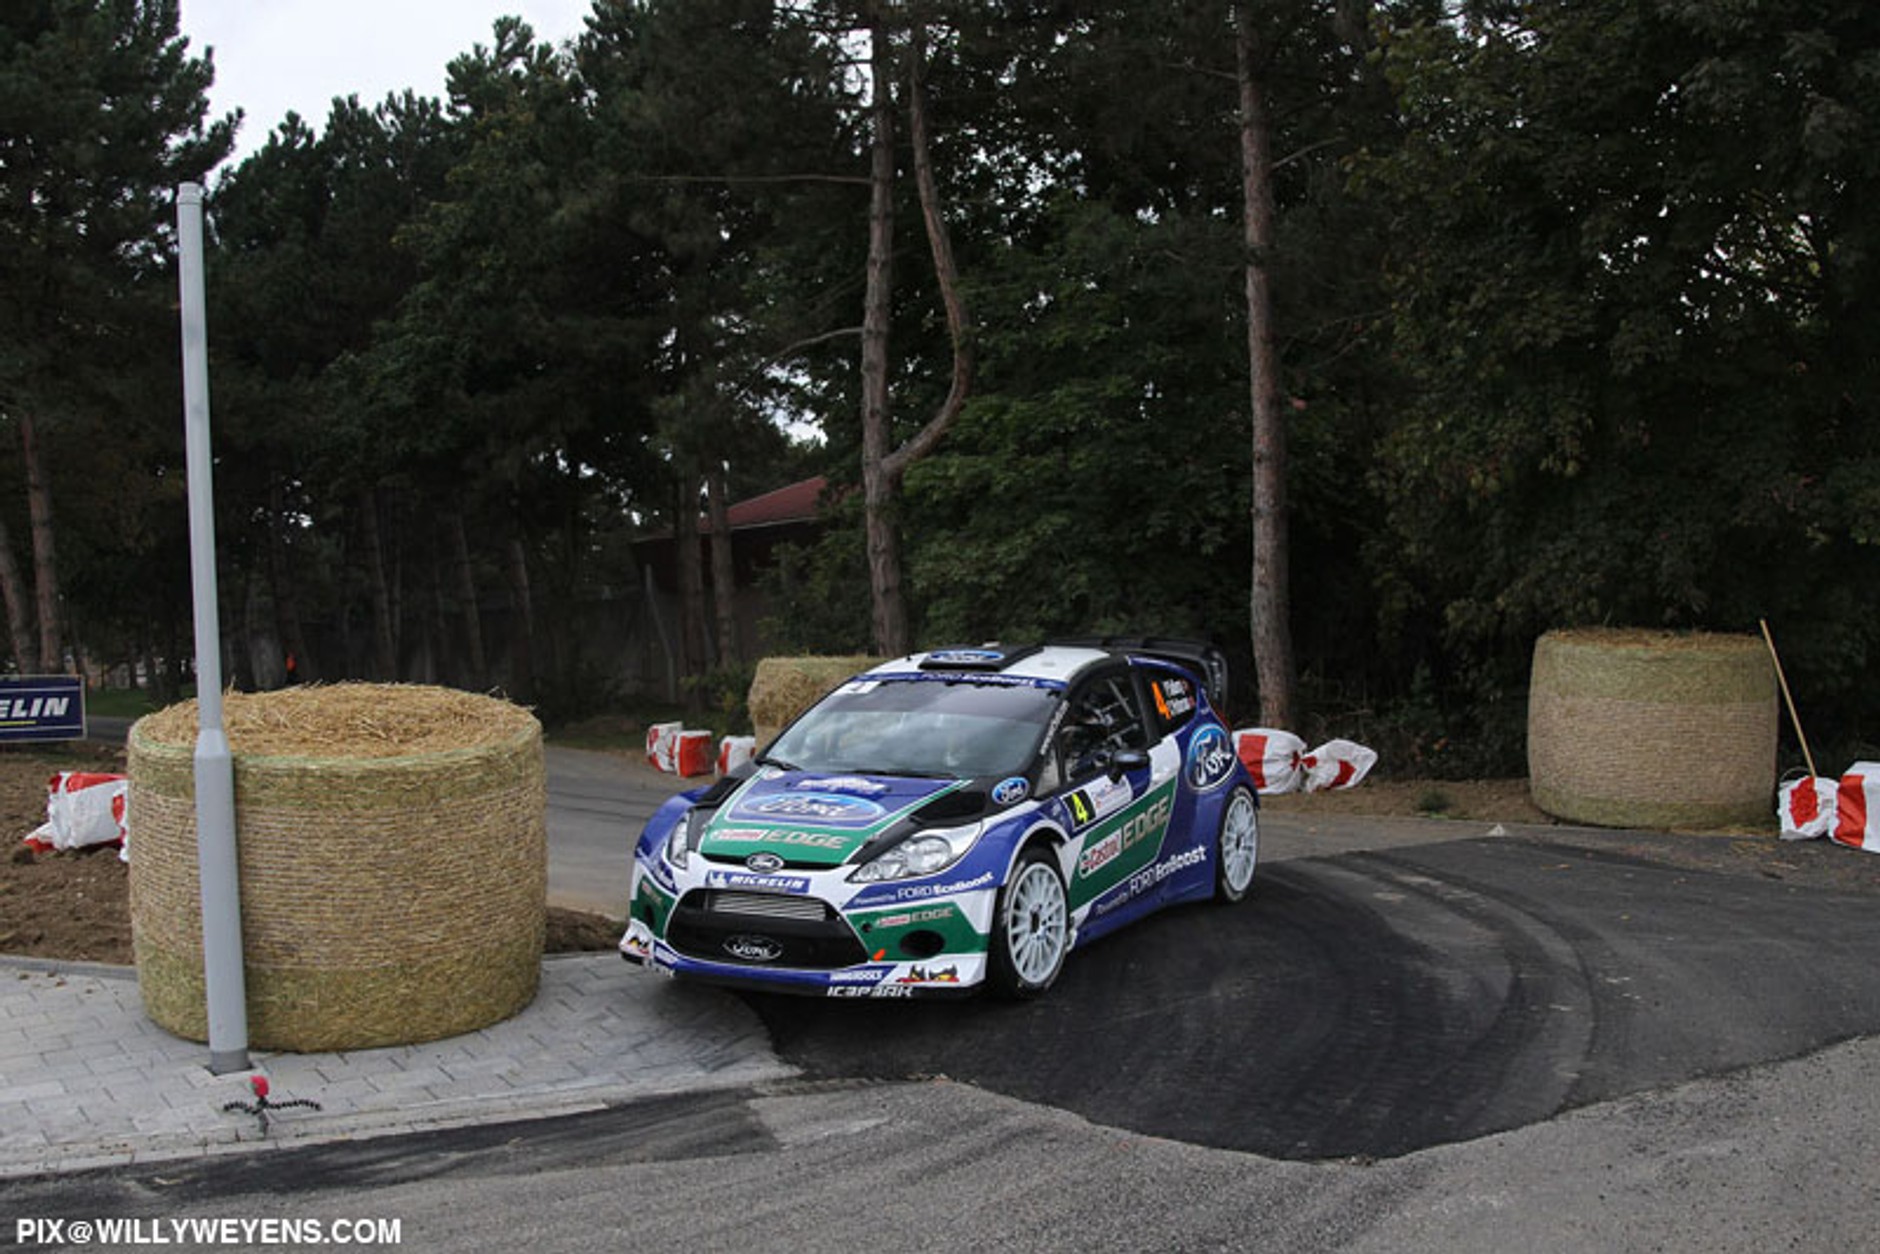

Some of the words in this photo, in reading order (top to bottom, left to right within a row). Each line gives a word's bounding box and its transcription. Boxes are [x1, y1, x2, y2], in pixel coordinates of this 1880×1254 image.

[1151, 681, 1172, 720] 4
[1072, 793, 1089, 823] 4
[1123, 796, 1170, 849] EDGE
[764, 829, 851, 849] EDGE
[730, 876, 806, 889] MICHELIN
[898, 885, 932, 899] FORD
[912, 907, 954, 922] EDGE
